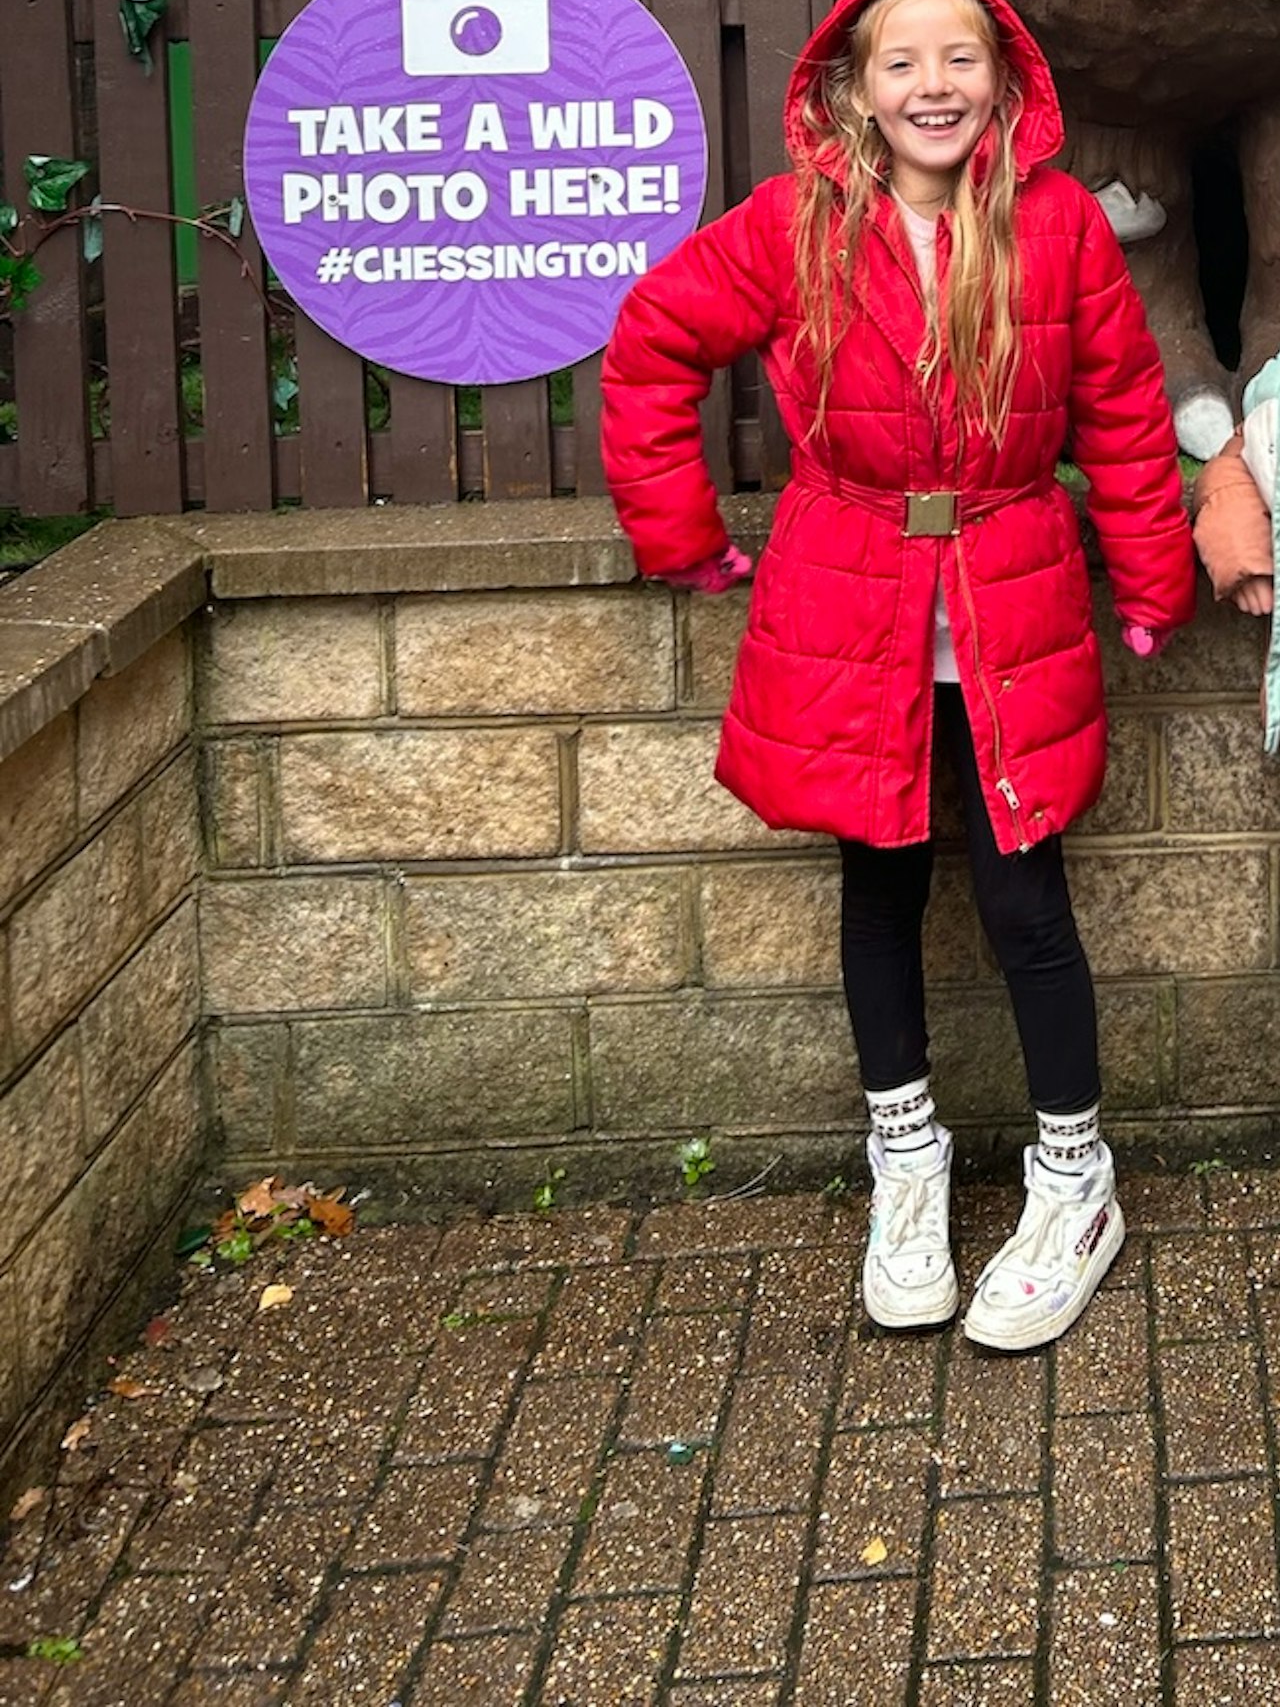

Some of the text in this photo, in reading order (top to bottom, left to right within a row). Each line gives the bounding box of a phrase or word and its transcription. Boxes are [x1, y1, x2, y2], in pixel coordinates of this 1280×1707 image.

[287, 97, 675, 157] TAKE A WILD
[282, 164, 683, 225] PHOTO HERE!
[316, 240, 649, 285] #CHESSINGTON
